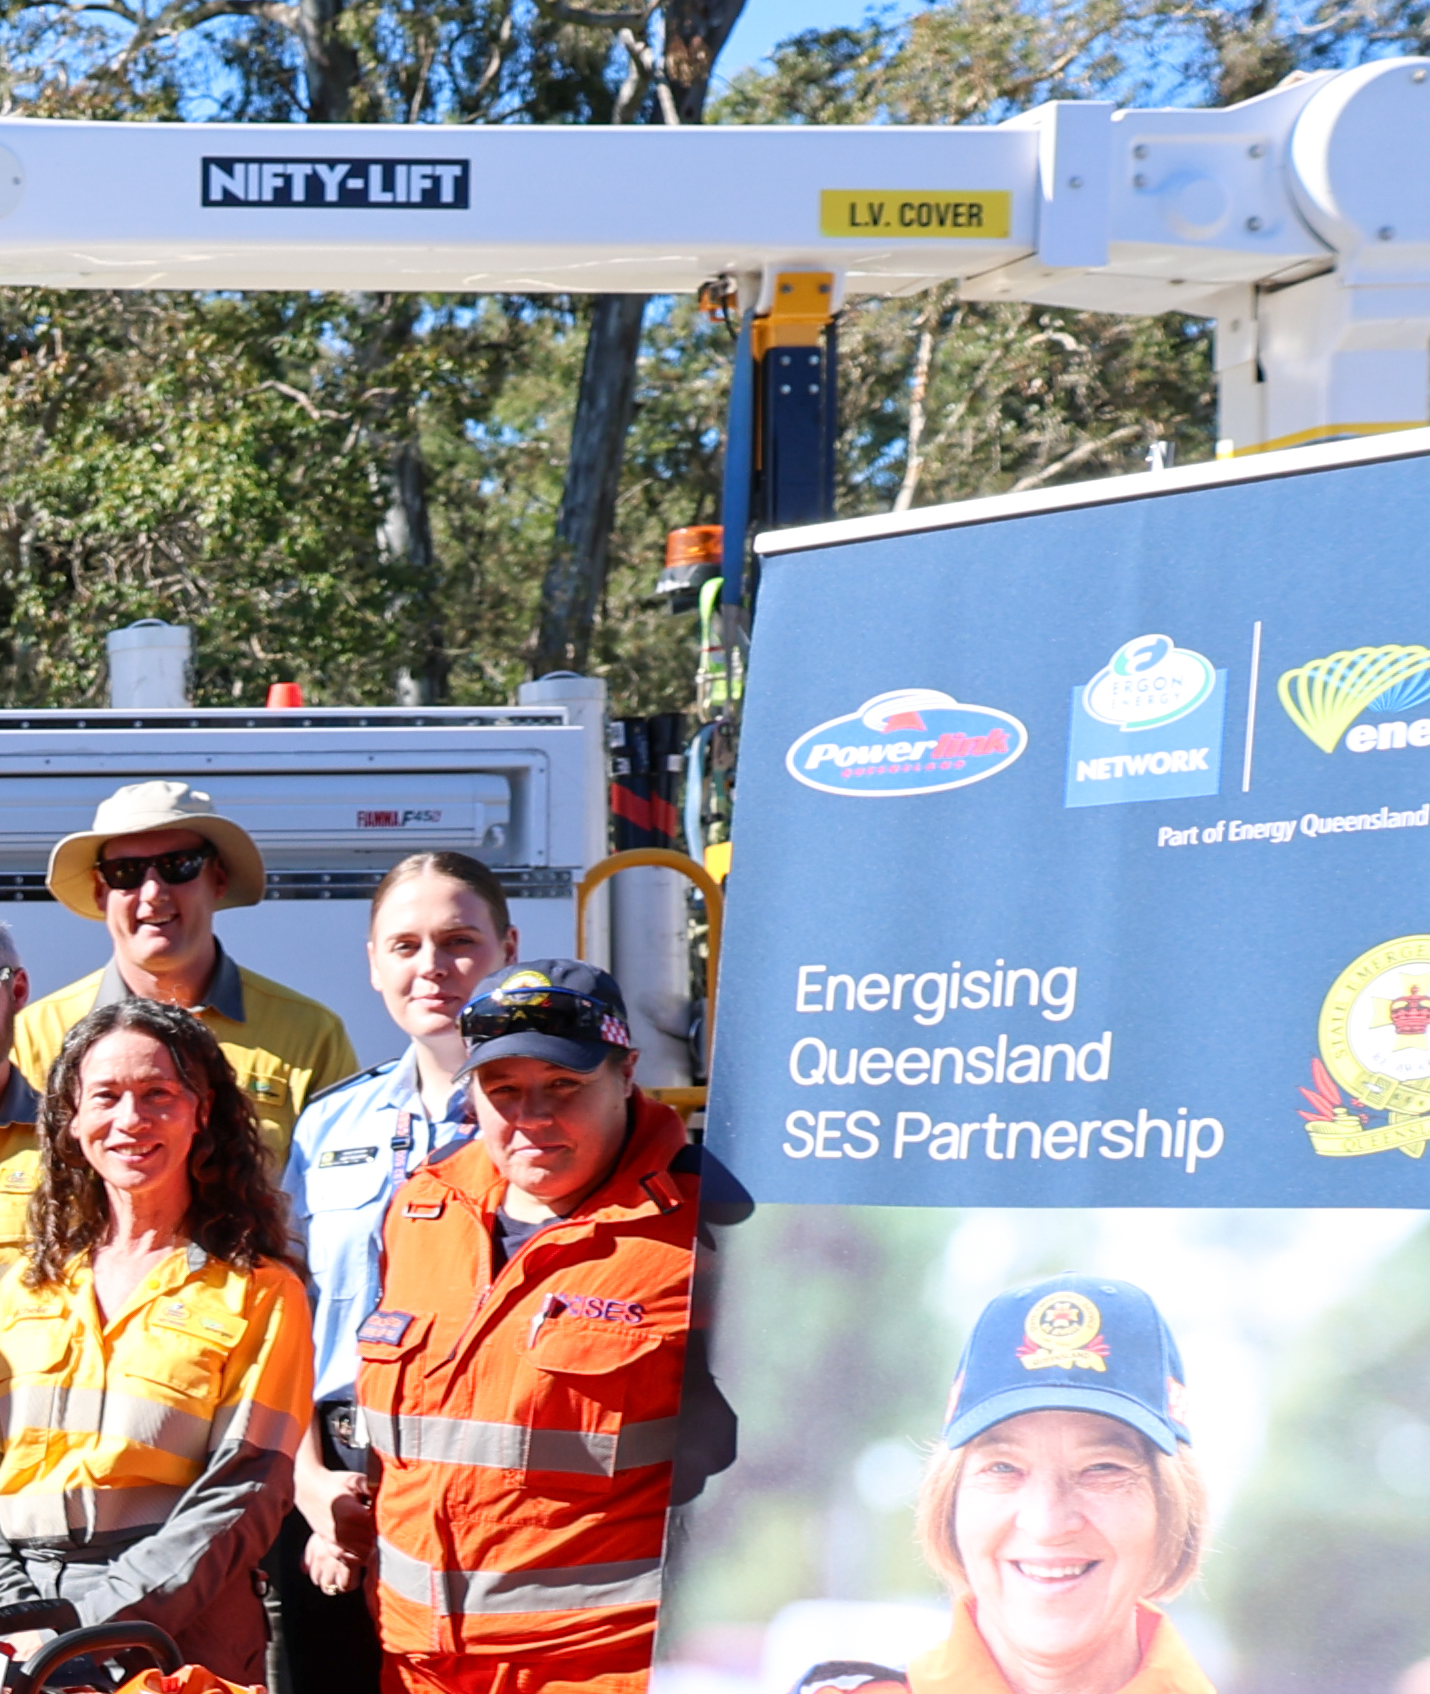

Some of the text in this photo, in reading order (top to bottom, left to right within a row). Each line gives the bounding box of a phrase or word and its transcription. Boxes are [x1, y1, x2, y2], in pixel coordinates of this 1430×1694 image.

[207, 162, 462, 204] NIFTY-LIFT
[848, 201, 983, 229] L.V. COVER
[1112, 676, 1184, 696] ERGON
[805, 728, 1008, 771] Powerlink
[1345, 718, 1430, 753] ene
[1077, 748, 1208, 782] NETWORK
[1158, 804, 1430, 848] Part of Energy Queensland
[1346, 943, 1430, 992] EMERGE
[796, 959, 1077, 1025] Energising
[790, 1031, 1111, 1086] Queensland
[782, 1108, 1224, 1173] SES Partnership
[1343, 1120, 1430, 1153] QUEENSL
[585, 1299, 645, 1323] SES
